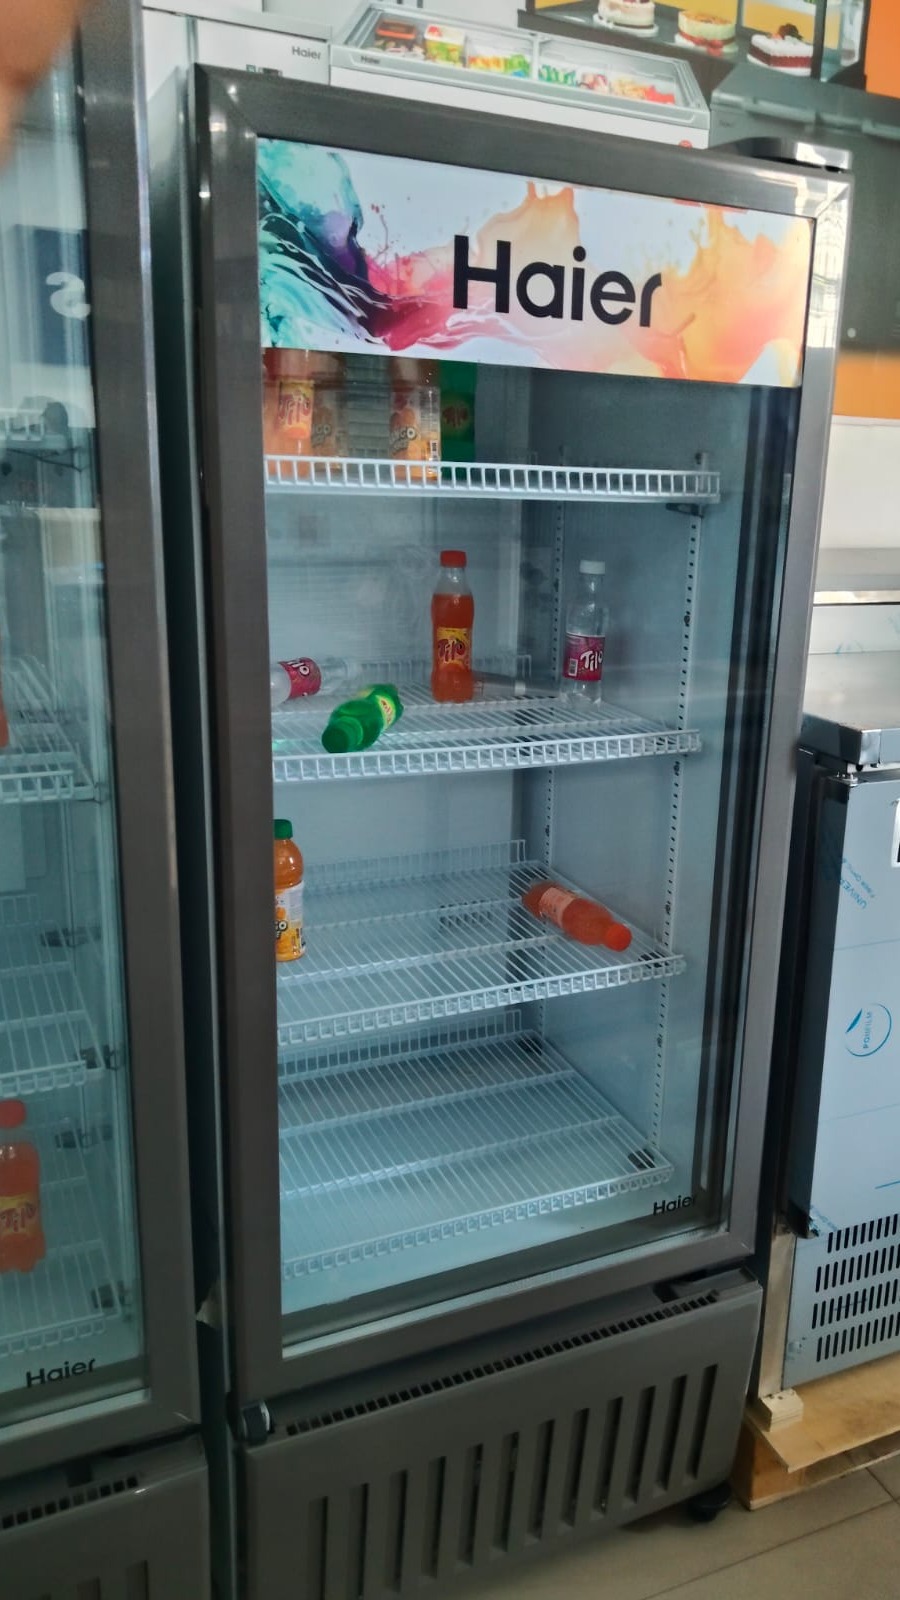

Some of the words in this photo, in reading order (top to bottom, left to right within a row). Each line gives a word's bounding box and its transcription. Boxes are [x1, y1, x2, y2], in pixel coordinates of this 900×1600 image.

[291, 46, 321, 60] Haier
[453, 235, 662, 328] Haier
[652, 1194, 696, 1217] Haier
[26, 1358, 96, 1388] Haier
